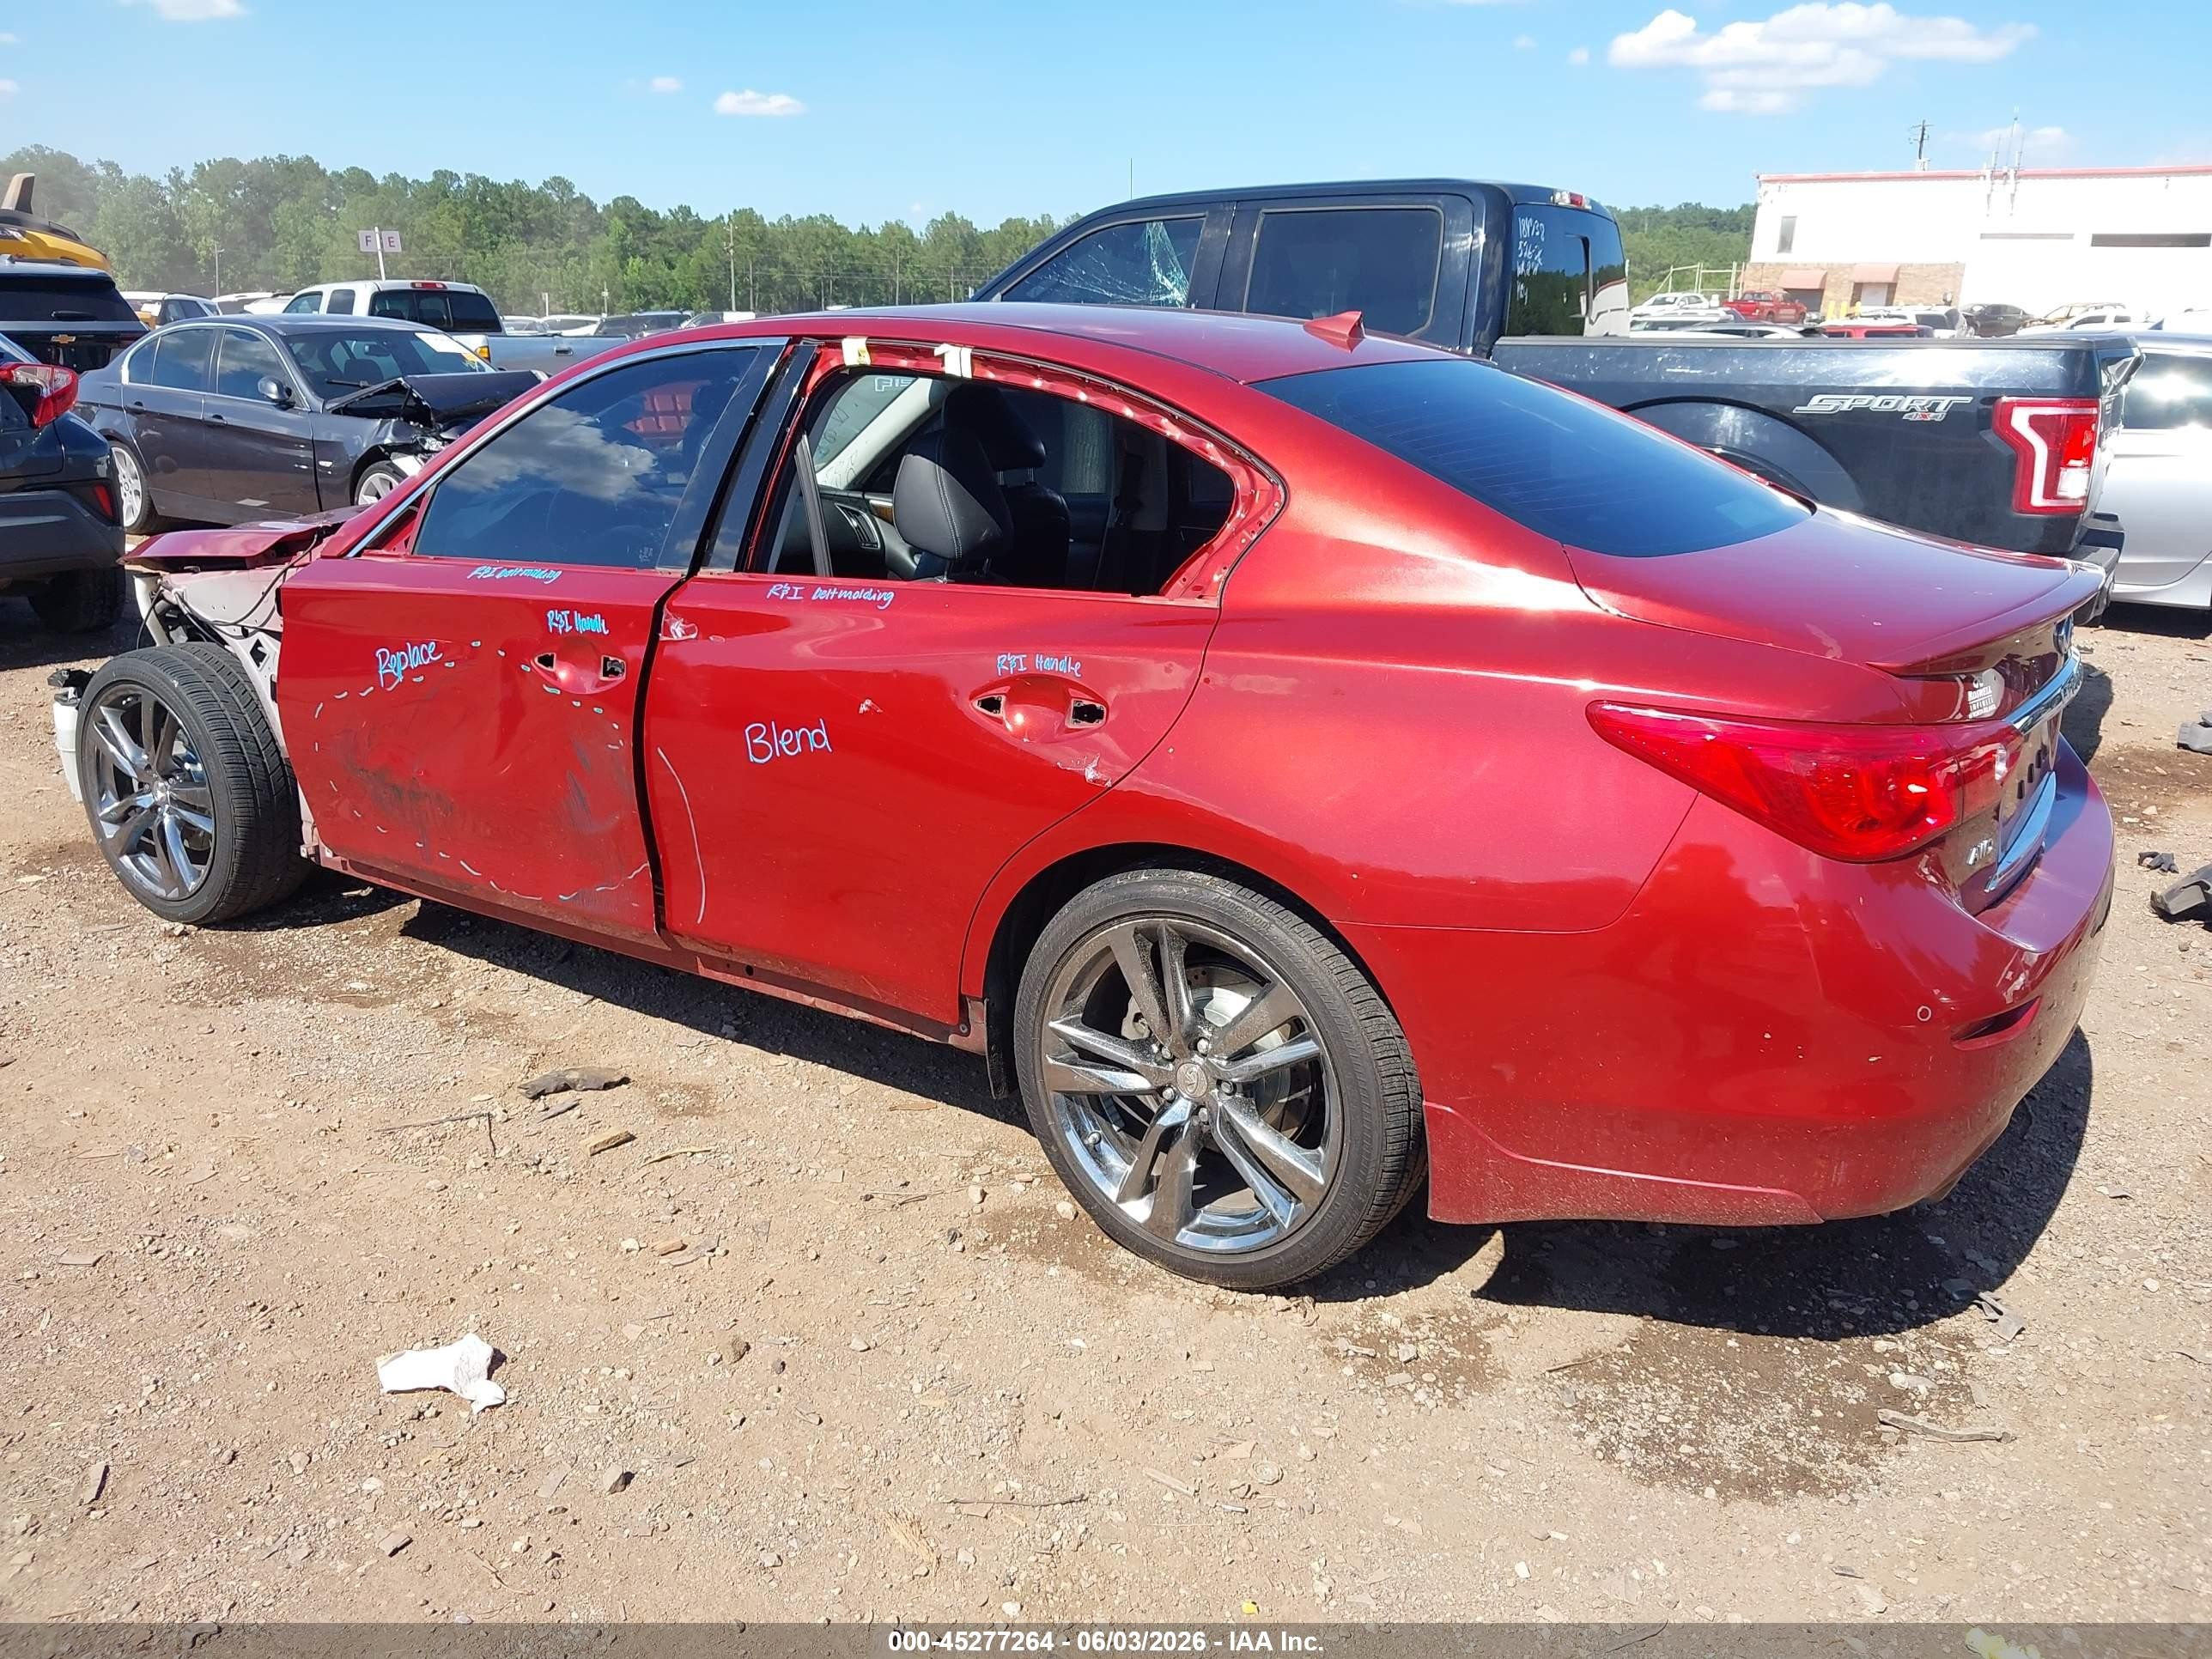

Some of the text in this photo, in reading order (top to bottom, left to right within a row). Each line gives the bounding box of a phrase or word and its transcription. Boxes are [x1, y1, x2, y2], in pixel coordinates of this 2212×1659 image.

[365, 235, 372, 247] F
[387, 236, 396, 248] E
[1792, 394, 1974, 414] SPORT
[375, 641, 443, 691] Replace
[1035, 653, 1082, 677] Handle
[744, 718, 832, 763] Blend
